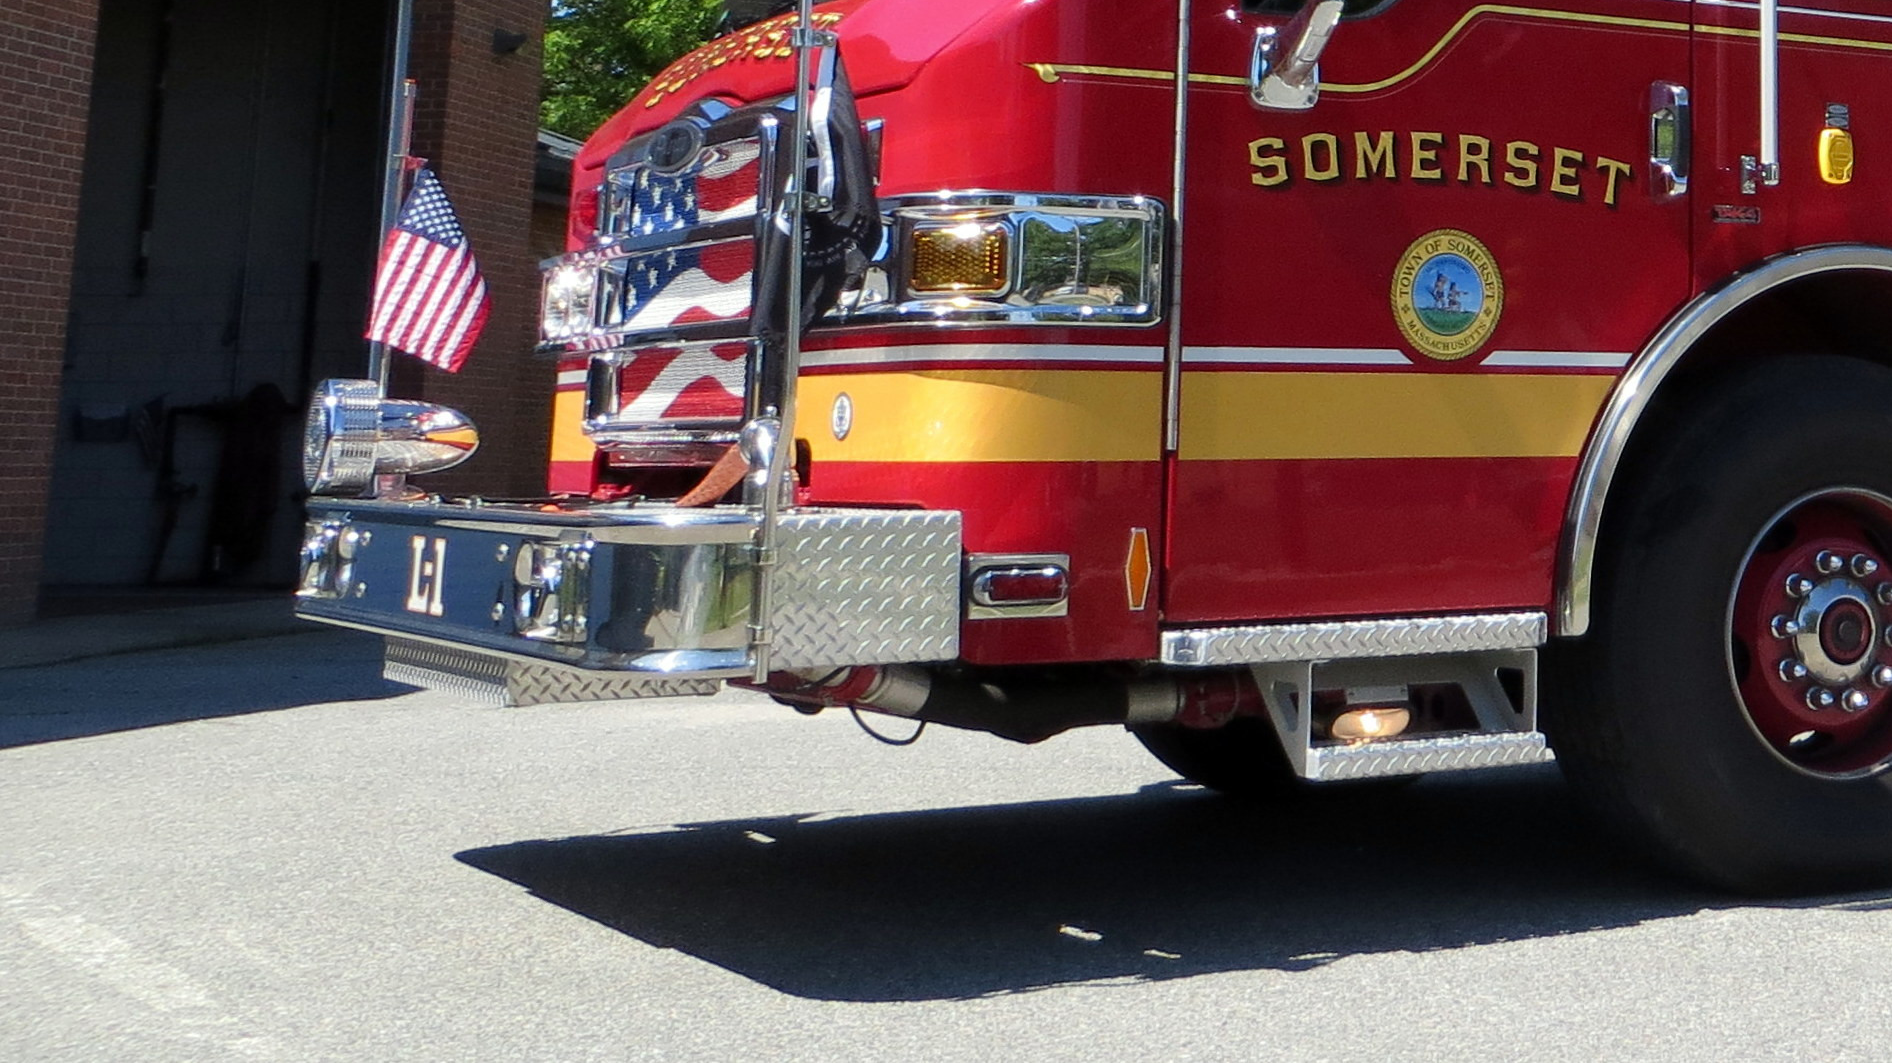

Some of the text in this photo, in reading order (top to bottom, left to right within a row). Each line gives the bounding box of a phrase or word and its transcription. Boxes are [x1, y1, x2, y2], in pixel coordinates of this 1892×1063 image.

[1248, 131, 1632, 205] SOMERSET
[1399, 252, 1424, 298] TOWN
[1424, 239, 1442, 255] OF
[1447, 239, 1496, 301] SOMERSET
[1407, 320, 1487, 351] MASSACHUSETTS
[406, 534, 447, 617] L-1
